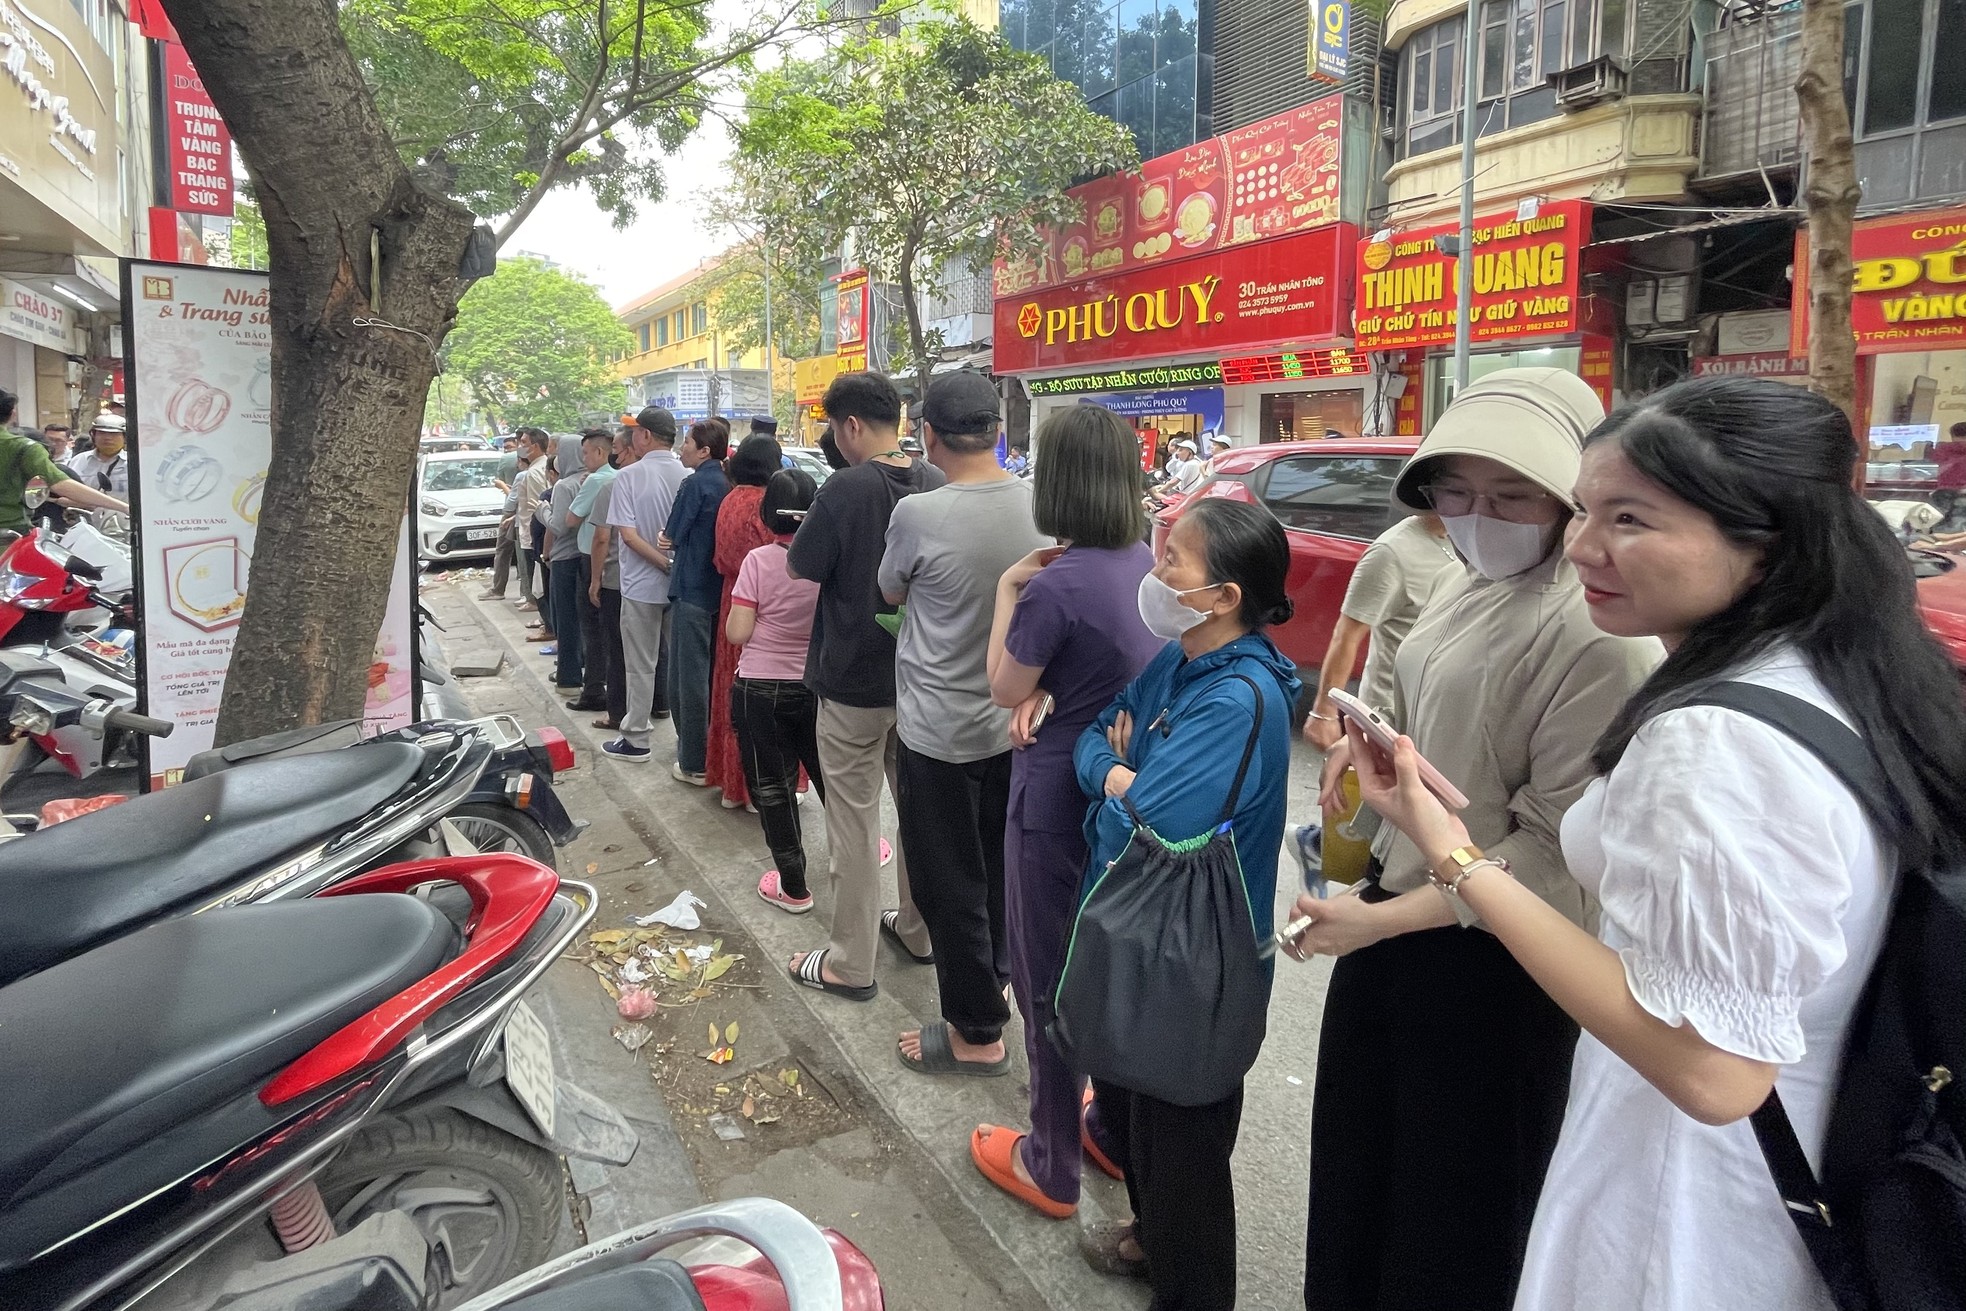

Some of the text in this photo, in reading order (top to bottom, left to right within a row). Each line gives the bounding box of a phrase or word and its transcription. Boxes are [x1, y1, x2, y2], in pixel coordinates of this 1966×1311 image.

[184, 120, 217, 137] TÂM
[181, 136, 222, 155] VÀNG
[187, 155, 217, 173] BẠC
[178, 171, 227, 190] TRANG
[189, 190, 219, 206] SỨC
[1395, 240, 1421, 257] CÔNG
[1424, 238, 1435, 252] TY
[1523, 214, 1565, 235] QUANG
[1362, 242, 1565, 312] THỊNH UANG
[1239, 276, 1324, 298] 30 TRẦN NHÂN TÔNG
[1045, 274, 1222, 346] PHÚ QUÝ
[1238, 294, 1288, 309] 024 3573 5959
[1238, 300, 1315, 318] www.phuquy.com.vn
[50, 306, 64, 324] 37
[159, 305, 173, 318] &
[180, 302, 243, 326] Trang
[1418, 308, 1443, 328] TÍN
[1446, 306, 1482, 325] NƯ
[1522, 296, 1570, 316] VÀNG
[219, 328, 241, 338] CỦA
[1862, 327, 1910, 340] TRẦN
[1914, 325, 1964, 337] NHÂN
[1330, 349, 1346, 357] BÁN
[1330, 358, 1351, 366] 11700
[1735, 356, 1786, 374] BÁNH
[1047, 379, 1062, 393] BỘ
[1064, 378, 1084, 391] SƯU
[1084, 376, 1103, 390] TẬP
[1105, 371, 1137, 388] NHẪN
[1138, 368, 1168, 386] CƯỚI
[1170, 367, 1202, 383] RING
[1106, 396, 1188, 410] THANH LONG PHÚ QUÝ
